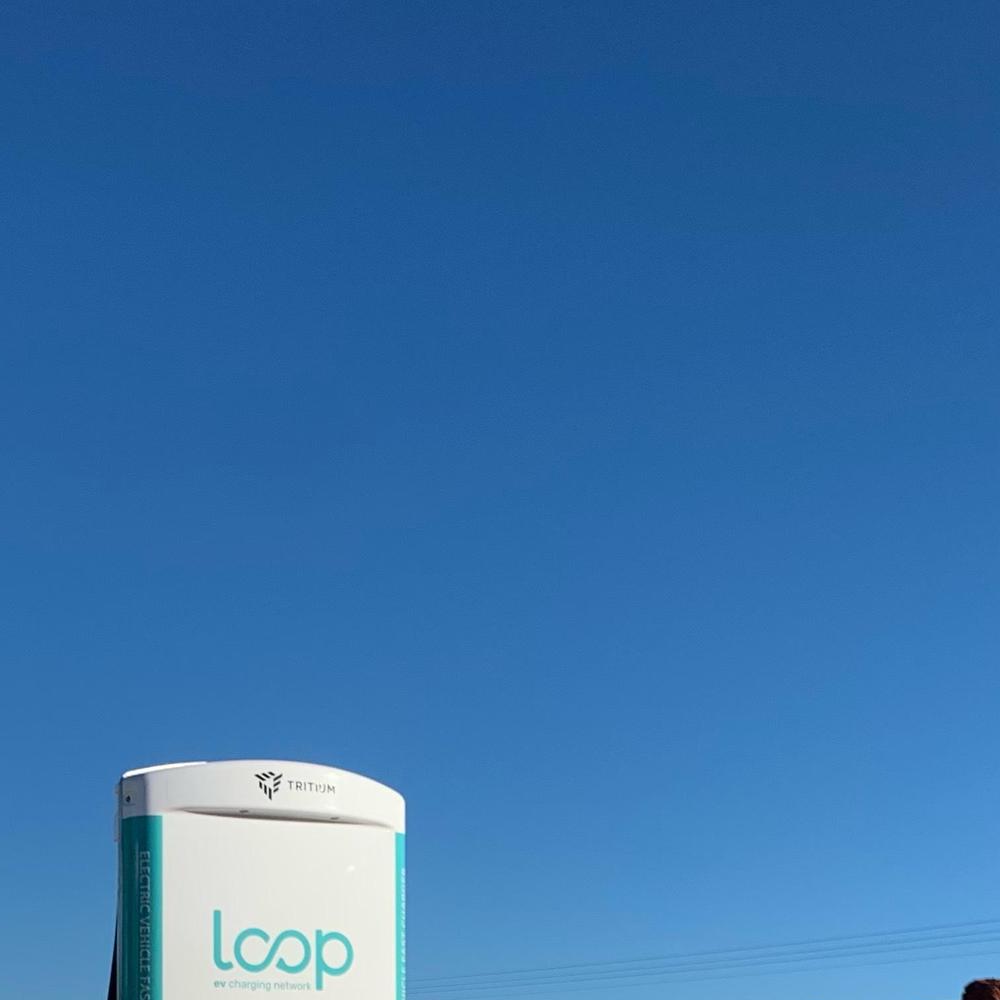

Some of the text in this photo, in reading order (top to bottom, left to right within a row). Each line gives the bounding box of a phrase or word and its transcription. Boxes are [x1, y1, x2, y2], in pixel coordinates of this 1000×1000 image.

[288, 780, 336, 794] TRITIUM
[213, 909, 354, 991] loop
[214, 979, 312, 992] ev charging network
